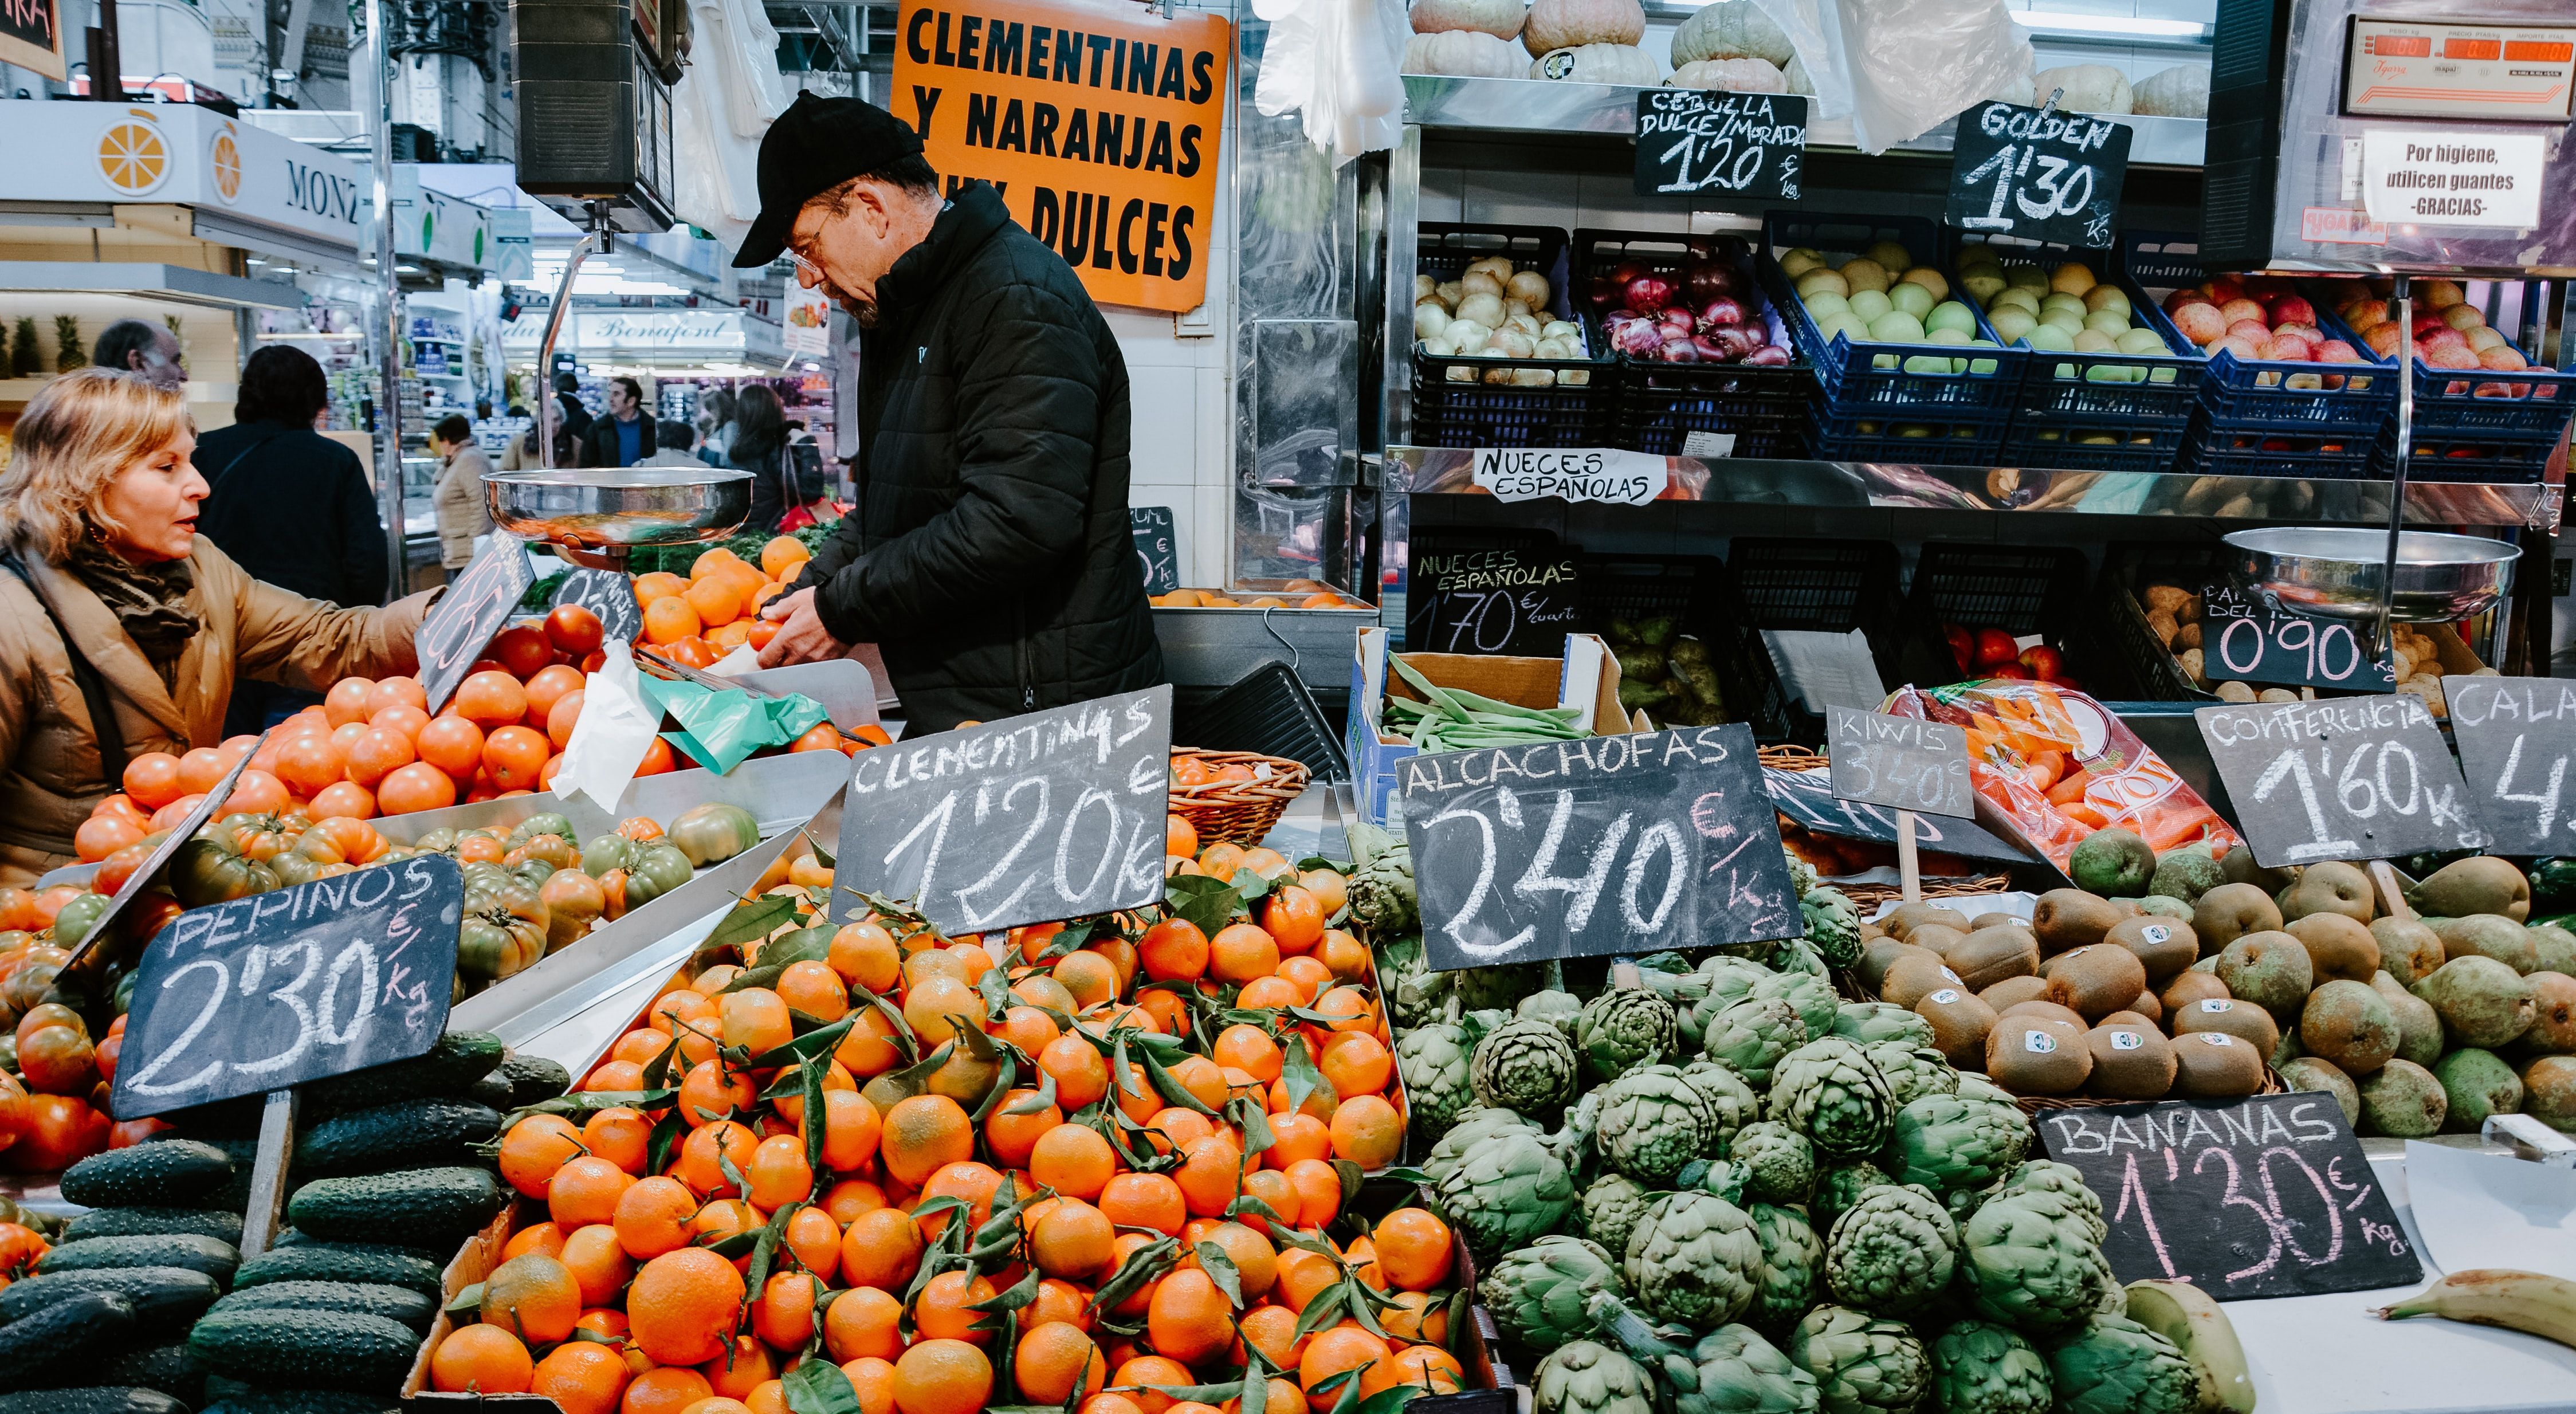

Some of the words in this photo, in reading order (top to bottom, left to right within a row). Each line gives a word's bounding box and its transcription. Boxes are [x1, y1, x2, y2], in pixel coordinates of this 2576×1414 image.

[907, 8, 1214, 105] CLEMENTINAS
[912, 85, 943, 140] Y
[965, 93, 1202, 178] NARANJAS
[1981, 102, 2114, 153] GOLDEN
[2406, 144, 2432, 162] Por
[2436, 144, 2498, 164] higiene,
[1658, 133, 1763, 193] 1'20
[1962, 143, 2093, 231] 1'30
[2386, 170, 2446, 188] utilicen
[2449, 174, 2514, 191] guantes
[1032, 186, 1195, 281] DULCES
[2410, 197, 2487, 216] -GRACIAS-
[596, 316, 727, 344] Bonafont
[1481, 448, 1604, 476] NUECES
[1495, 472, 1649, 502] ESPAÑOLAS
[1419, 551, 1517, 576] NUECES
[1438, 561, 1576, 590] ESPAÑOLAS
[1410, 590, 1515, 651] 1'70
[2209, 604, 2256, 618] DEL
[2220, 618, 2360, 681] 0'90
[1837, 712, 1947, 751] KIWIS
[1407, 726, 1728, 798] ALCACHOFAS
[2253, 740, 2419, 861] 1'60
[883, 776, 1122, 926] 1'20
[1421, 788, 1689, 961] 2'40
[166, 857, 433, 958] PEPINOS
[125, 937, 379, 1097] 2'30
[2049, 1102, 2338, 1156] BANANAS
[2115, 1145, 2343, 1283] 1'30
